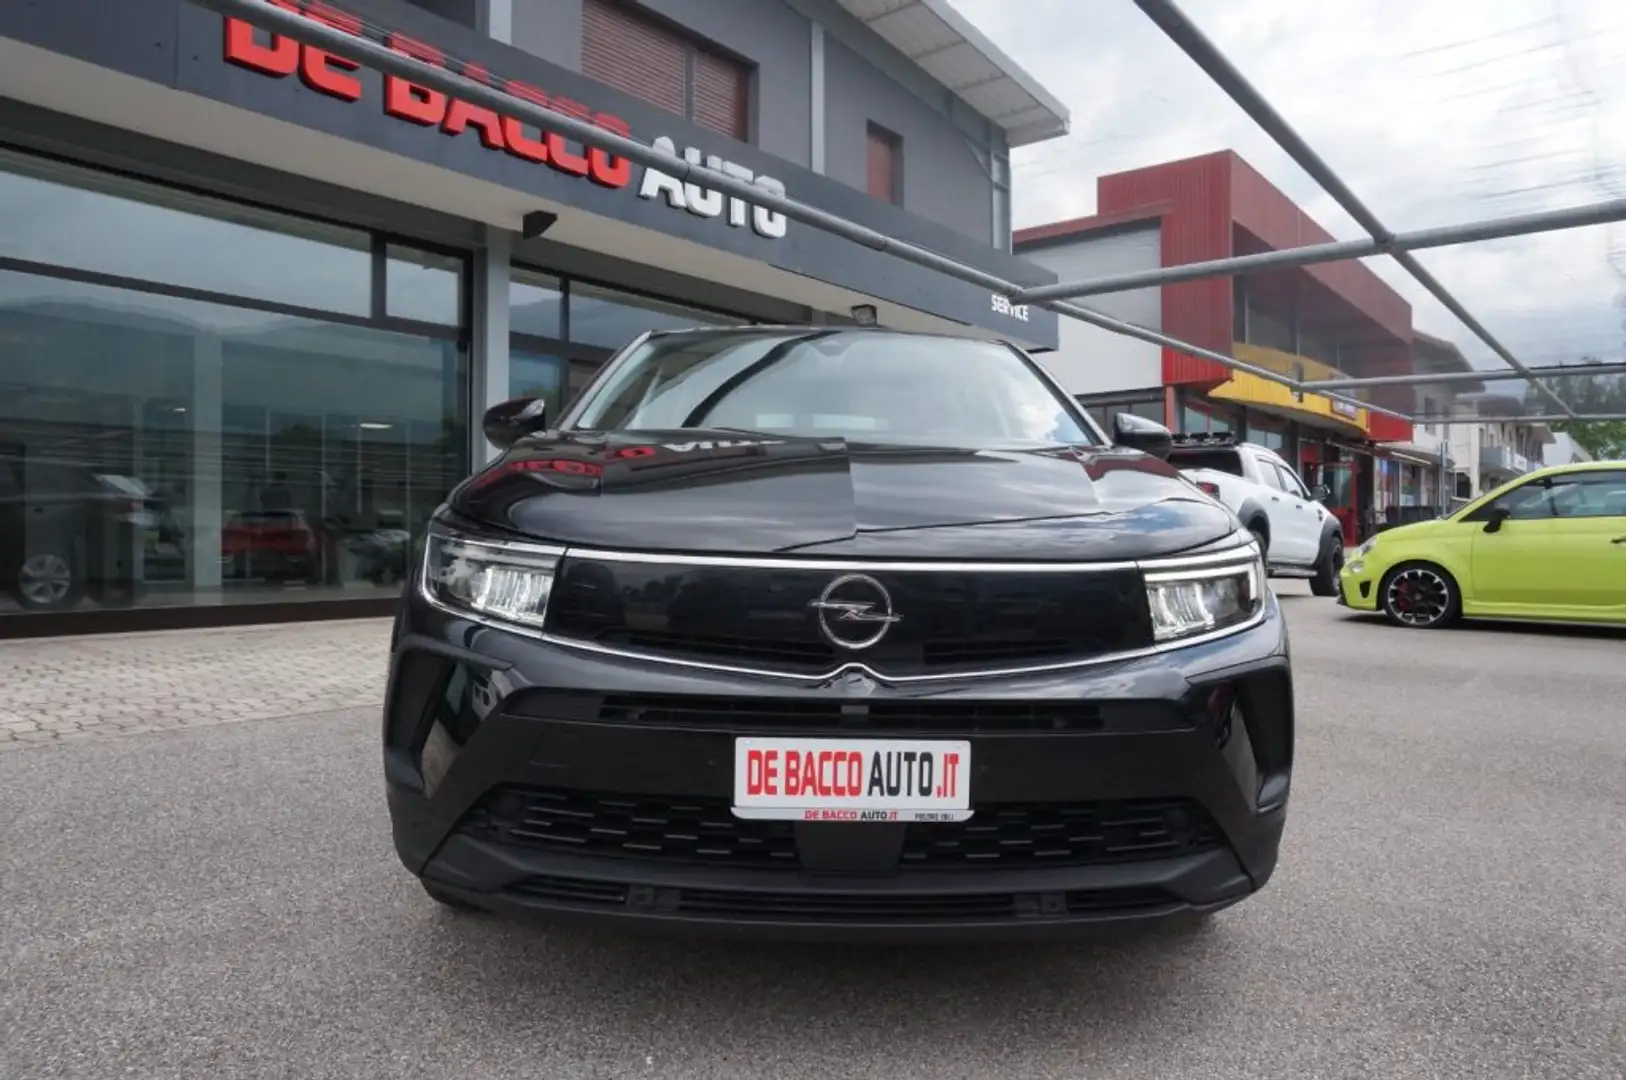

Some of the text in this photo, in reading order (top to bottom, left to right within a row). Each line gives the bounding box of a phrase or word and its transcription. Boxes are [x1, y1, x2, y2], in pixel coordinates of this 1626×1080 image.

[639, 135, 786, 238] AUTO
[991, 294, 1029, 321] SERVICE
[747, 750, 778, 796] DE
[784, 750, 863, 797] BACCO
[805, 810, 819, 820] DE
[822, 811, 857, 820] BACCO
